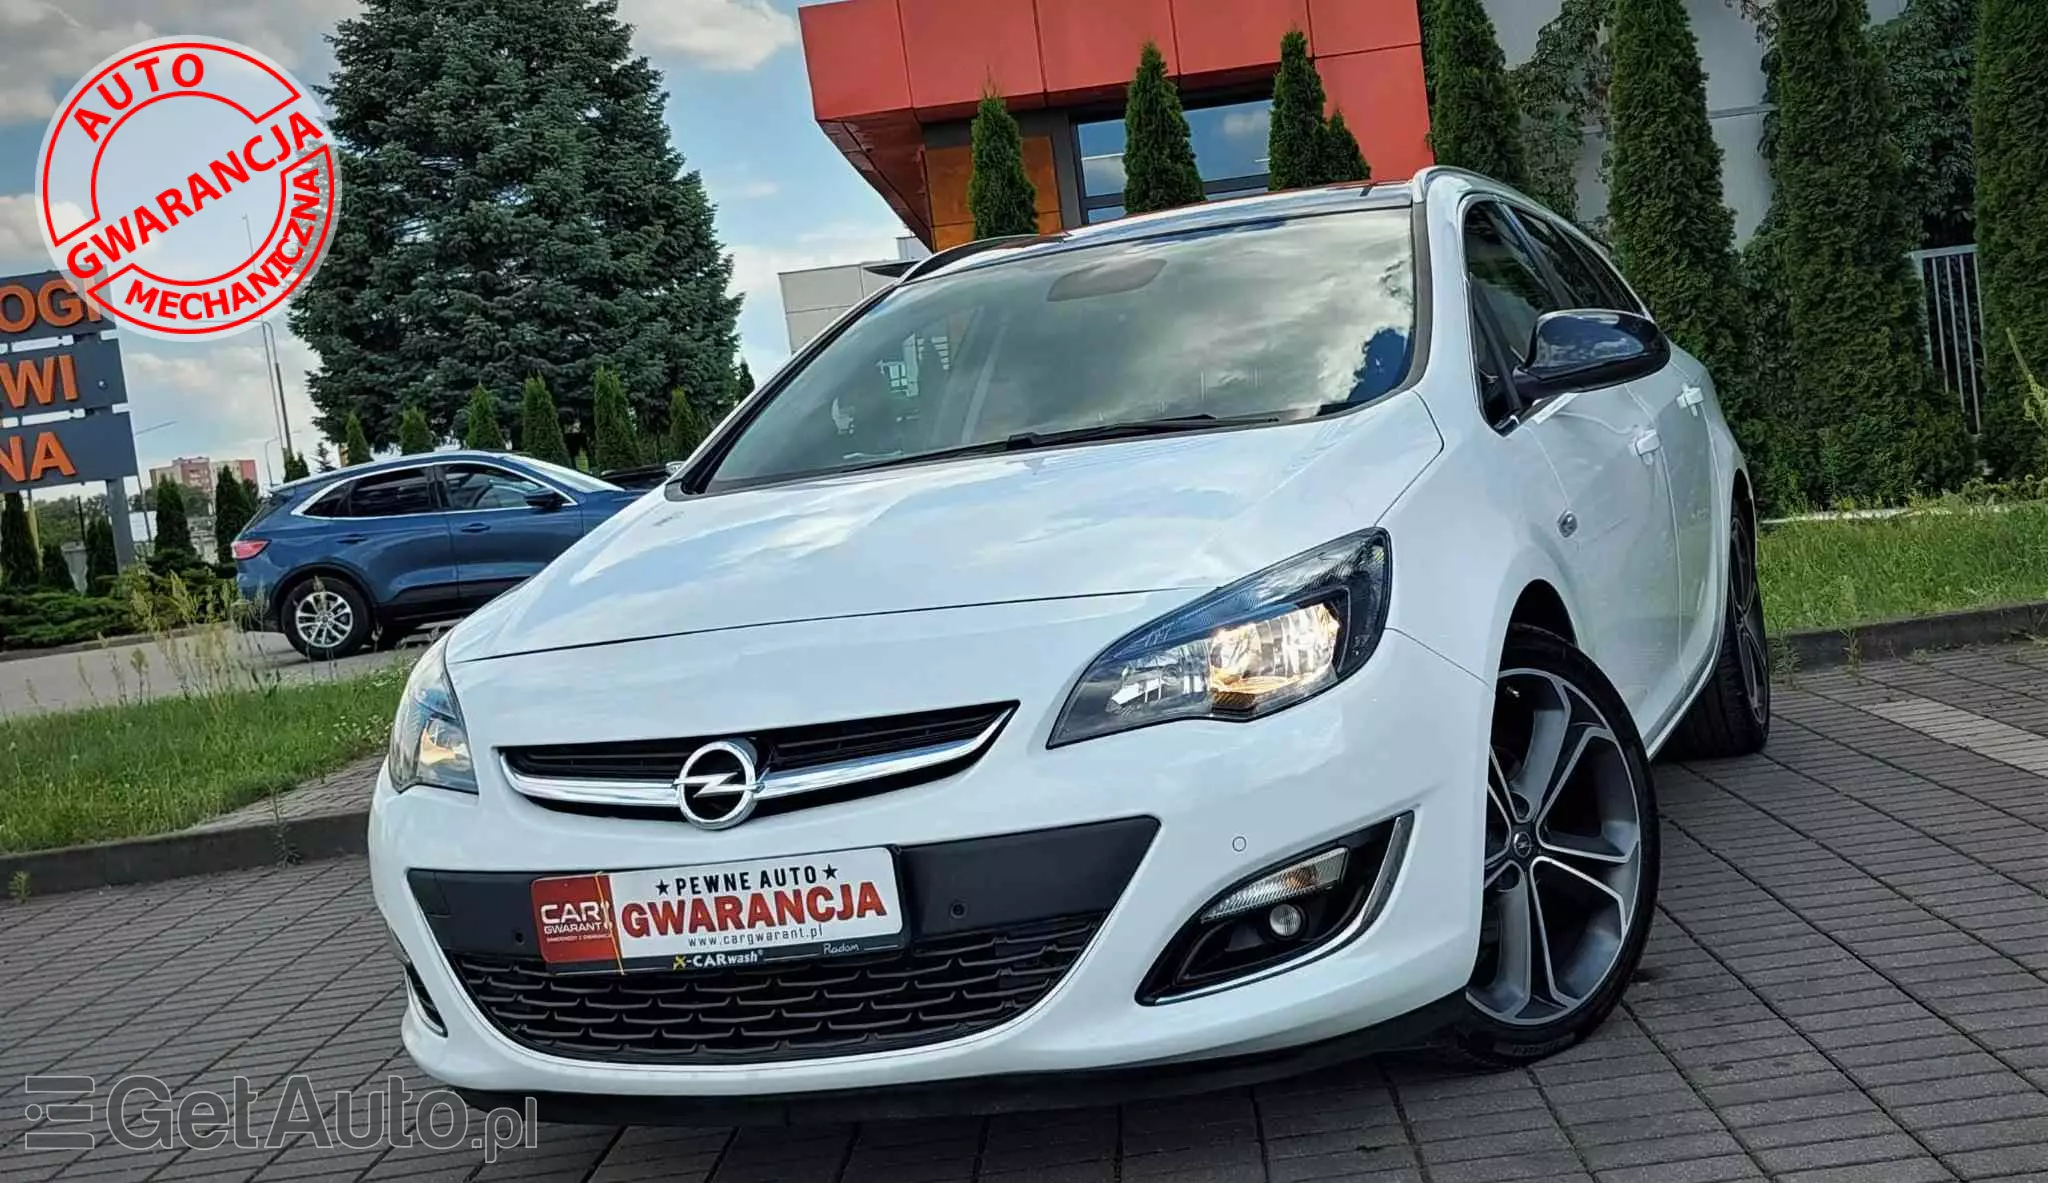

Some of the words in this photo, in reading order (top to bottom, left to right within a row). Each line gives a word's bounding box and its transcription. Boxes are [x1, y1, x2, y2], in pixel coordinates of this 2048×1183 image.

[675, 870, 750, 896] PEWNE
[760, 865, 817, 890] AUTO
[540, 901, 601, 924] CAR
[620, 881, 887, 938] GWARANCJA
[688, 924, 823, 949] www.cargwarant.pl
